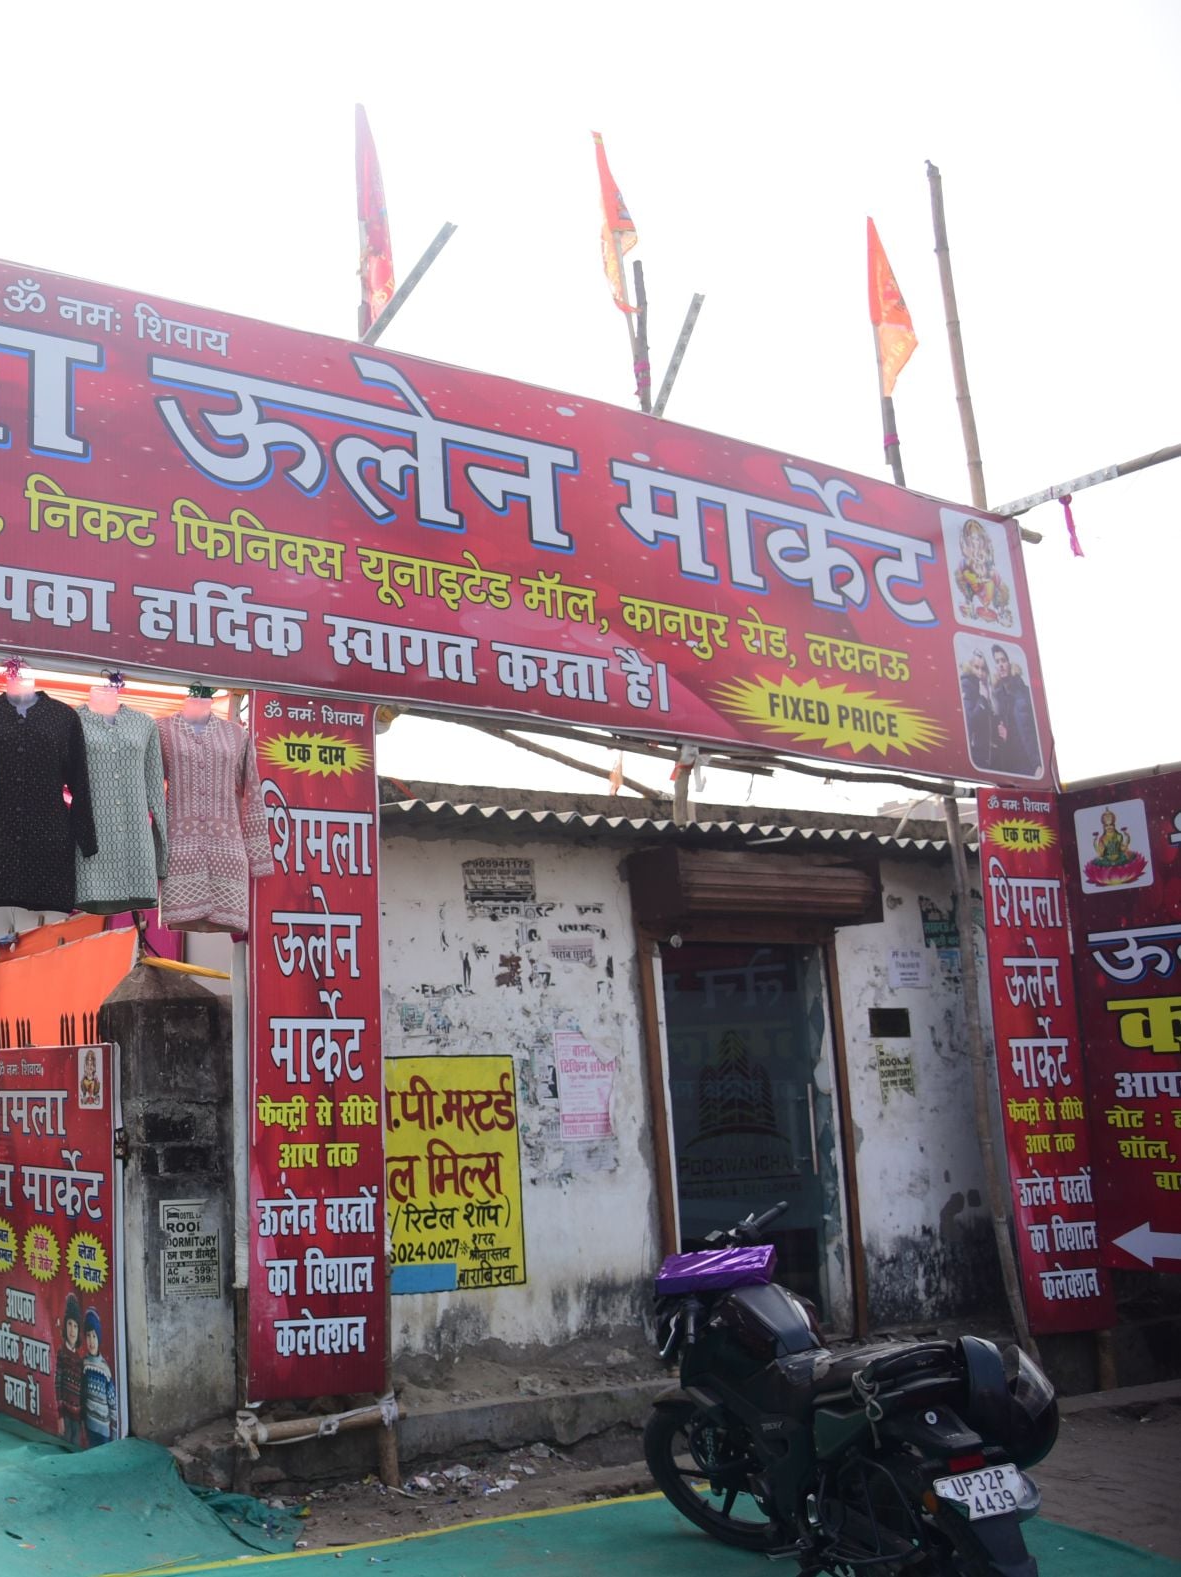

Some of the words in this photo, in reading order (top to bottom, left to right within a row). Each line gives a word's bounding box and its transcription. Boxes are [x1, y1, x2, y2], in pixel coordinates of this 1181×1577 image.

[2, 278, 45, 313] ॐ
[58, 295, 122, 333] नमः
[135, 302, 229, 356] शिवाय
[149, 353, 579, 553] ऊलेन
[610, 464, 939, 628] मार्केट
[24, 472, 158, 549] निकट
[171, 498, 345, 580] फिनिक्स
[357, 550, 513, 611] यूनाइटेड
[520, 571, 610, 634] मॉल,
[619, 592, 728, 662] कानपुर
[740, 607, 797, 668] रोड,
[805, 631, 911, 683] लखनऊ
[132, 580, 308, 658] हार्दिक
[323, 612, 478, 685] स्वागत
[490, 640, 608, 704] करता
[287, 707, 316, 722] नमः
[321, 705, 365, 726] शिवाय
[768, 693, 830, 726] FIXED
[837, 704, 899, 738] PRICE
[285, 742, 312, 763] एक
[317, 745, 346, 766] दाम
[261, 779, 374, 877] शिमला
[1002, 826, 1019, 843] एक
[1022, 828, 1040, 844] दाम
[988, 856, 1062, 928] शिमला
[271, 885, 362, 979] ऊलेन
[1003, 936, 1061, 1008] ऊलेन
[269, 989, 365, 1084] मार्केट
[1008, 1016, 1072, 1088] मार्केट
[1114, 1072, 1181, 1098] आप
[257, 1095, 309, 1132] फैक्ट्री
[315, 1095, 333, 1126] से
[339, 1094, 378, 1126] सीधे
[1043, 1097, 1056, 1121] से
[1058, 1096, 1084, 1120] सीधे
[1105, 1105, 1144, 1129] नोट
[279, 1143, 319, 1169] आप
[325, 1143, 359, 1168] तक
[1025, 1134, 1051, 1154] आप
[1054, 1133, 1075, 1152] तक
[21, 1149, 104, 1220] मार्केट
[425, 1138, 505, 1199] मिल्स
[1017, 1169, 1056, 1206] ऊलेन
[257, 1188, 318, 1236] ऊलेन
[324, 1185, 378, 1234] वस्त्रों
[1028, 1224, 1049, 1254] का
[1052, 1215, 1098, 1252] विशाल
[266, 1256, 297, 1298] का
[304, 1248, 374, 1296] विशाल
[1039, 1262, 1100, 1300] कलेक्शन
[6, 1287, 36, 1325] आपका
[274, 1308, 367, 1357] कलेक्शन
[950, 1469, 1005, 1497] UP32P
[962, 1490, 1017, 1515] 4439
